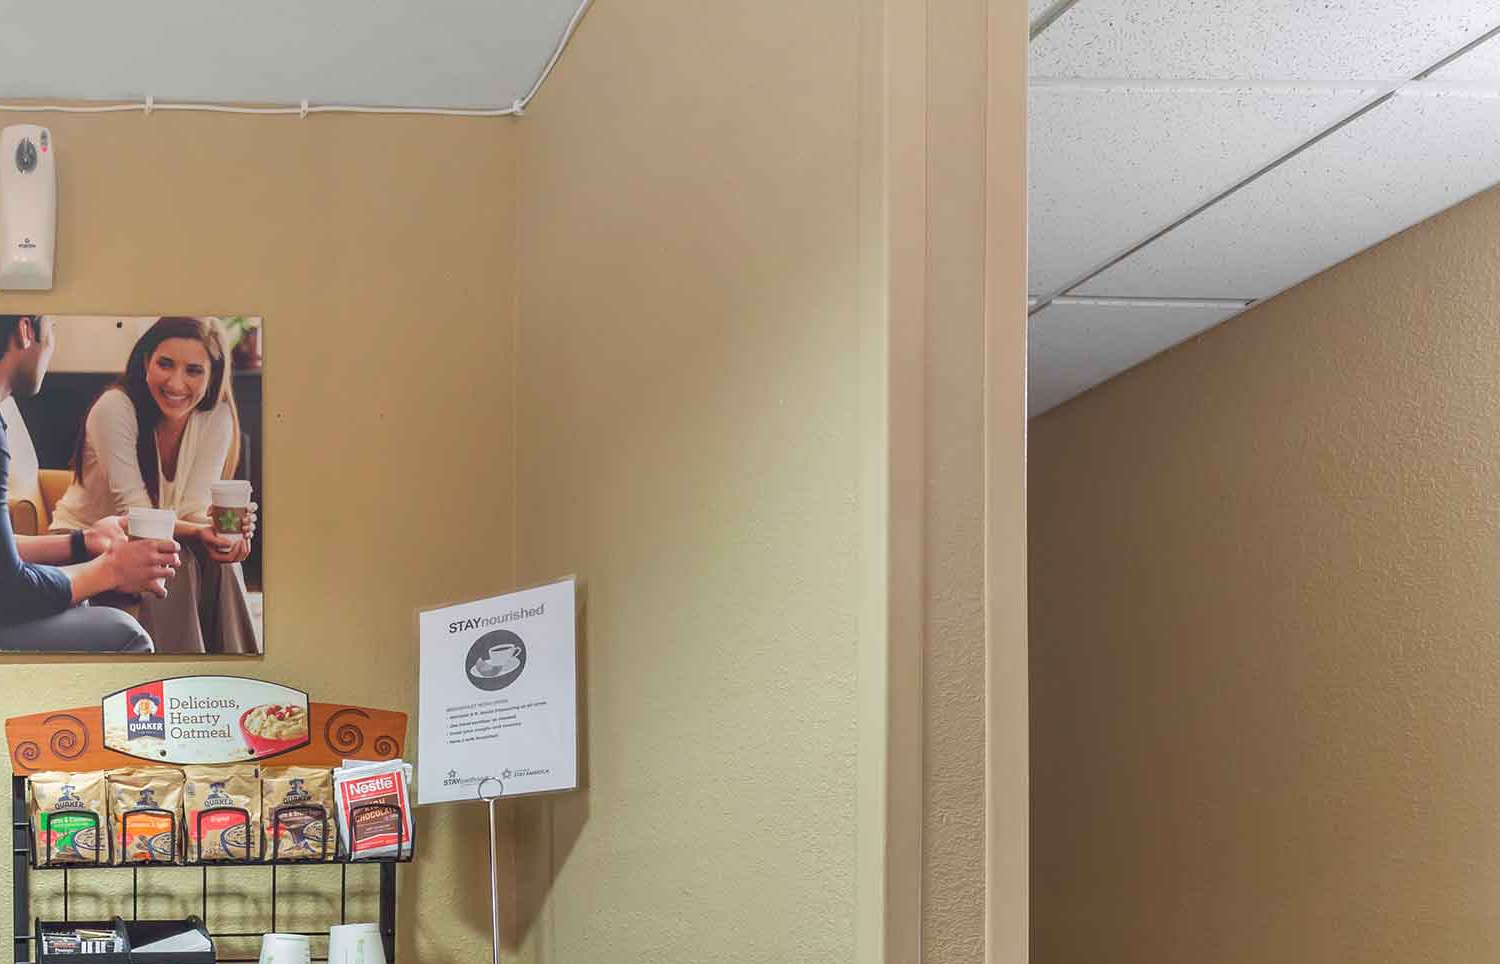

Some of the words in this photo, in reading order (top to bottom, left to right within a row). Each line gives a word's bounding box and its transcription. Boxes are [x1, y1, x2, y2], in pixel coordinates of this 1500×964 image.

[448, 603, 545, 634] STAYnourished
[169, 696, 241, 711] Delicious,
[129, 721, 164, 733] QUAKER
[170, 712, 220, 727] Hearty
[170, 724, 232, 740] Oatmeal
[54, 801, 85, 810] QUAKER
[204, 798, 234, 808] QUAKER
